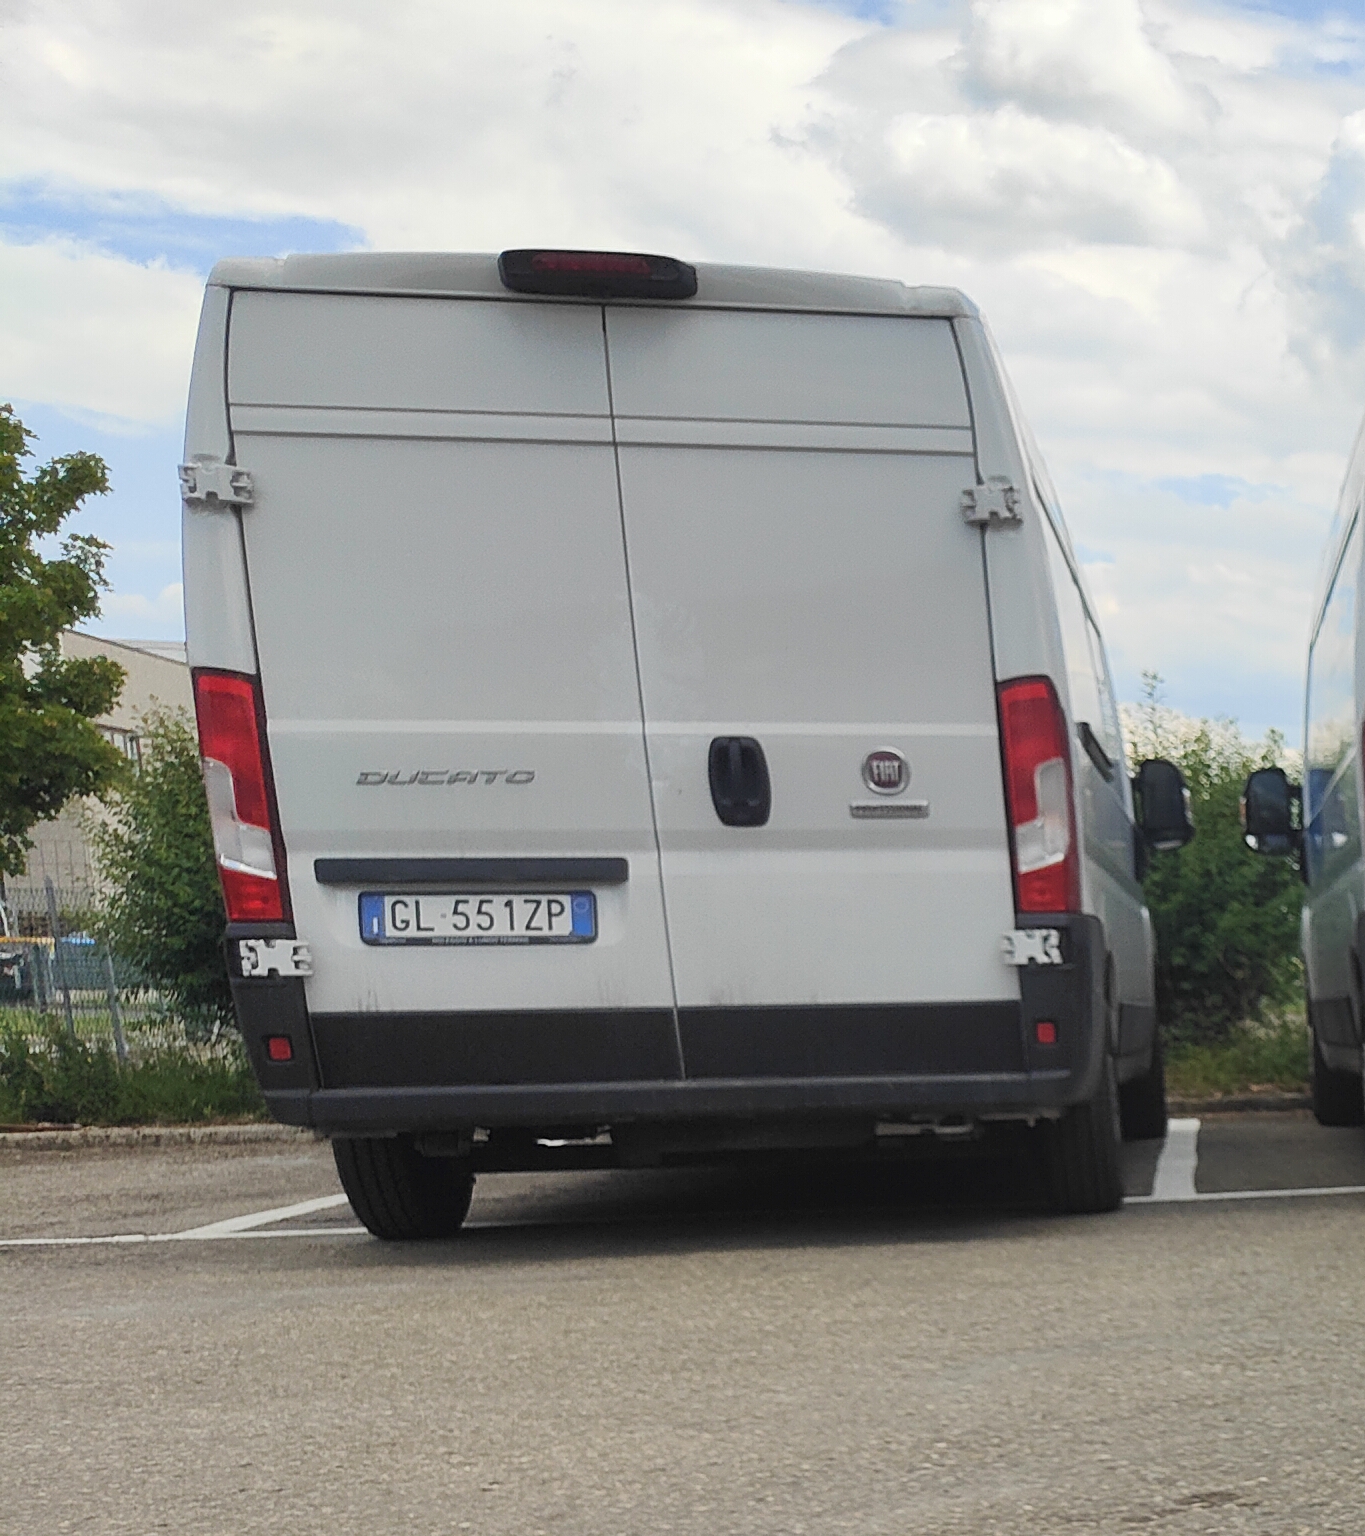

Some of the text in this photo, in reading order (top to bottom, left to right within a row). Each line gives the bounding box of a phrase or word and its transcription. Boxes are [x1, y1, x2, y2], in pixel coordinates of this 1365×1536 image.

[356, 769, 536, 786] DUCATO
[870, 760, 900, 782] FIAT
[390, 899, 435, 931] GL
[452, 899, 566, 931] 551ZP
